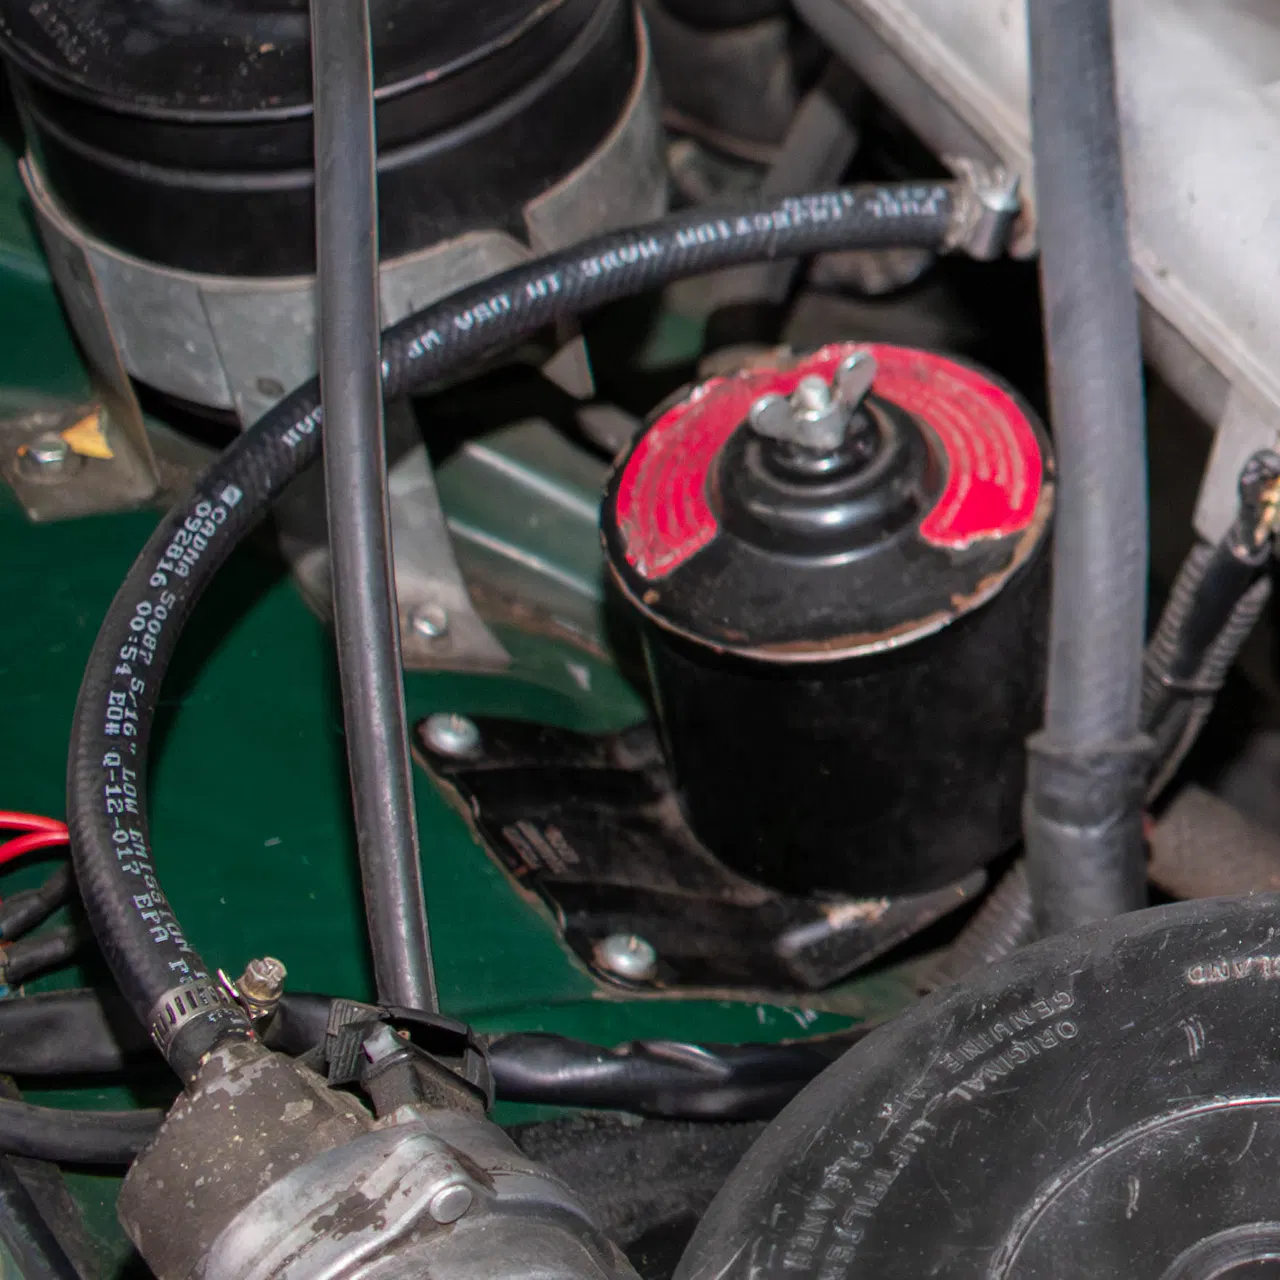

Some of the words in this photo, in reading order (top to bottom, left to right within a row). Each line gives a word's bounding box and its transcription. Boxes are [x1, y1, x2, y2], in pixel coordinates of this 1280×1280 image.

[526, 273, 561, 300] IN
[580, 237, 662, 278] MADE
[453, 294, 511, 331] USA
[150, 501, 213, 587] 092816
[175, 506, 227, 578] CADNA
[115, 600, 152, 676] 00:54
[139, 590, 177, 666] 50087
[122, 677, 146, 755] 5/16"
[102, 751, 142, 876] Q-12-017
[121, 767, 139, 814] LOW
[129, 828, 195, 954] EMISSION
[133, 893, 170, 944] EPA
[940, 991, 1076, 1074] GENUINE
[946, 1020, 1080, 1101] ORIGINAL
